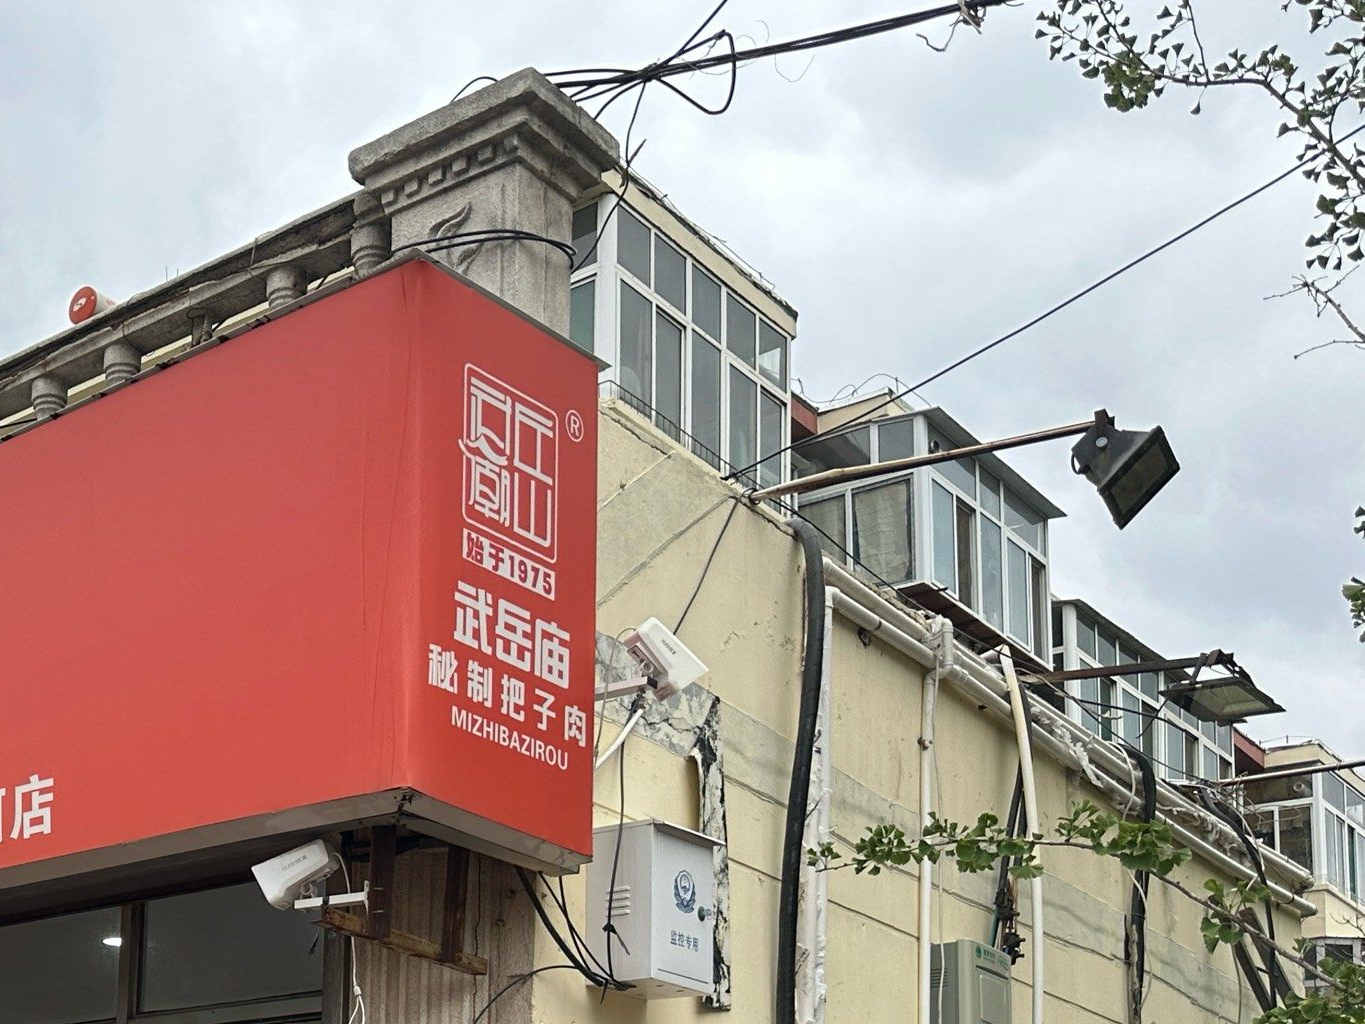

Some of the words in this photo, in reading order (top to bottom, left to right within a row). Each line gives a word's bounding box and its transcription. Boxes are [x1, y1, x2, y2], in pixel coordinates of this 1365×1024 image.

[466, 532, 553, 596] 始于1975
[454, 580, 570, 689] 武岳庙
[428, 643, 586, 747] 秘制把子肉
[451, 706, 568, 770] MIZHIBAZIROU
[670, 930, 699, 952] 监控专用
